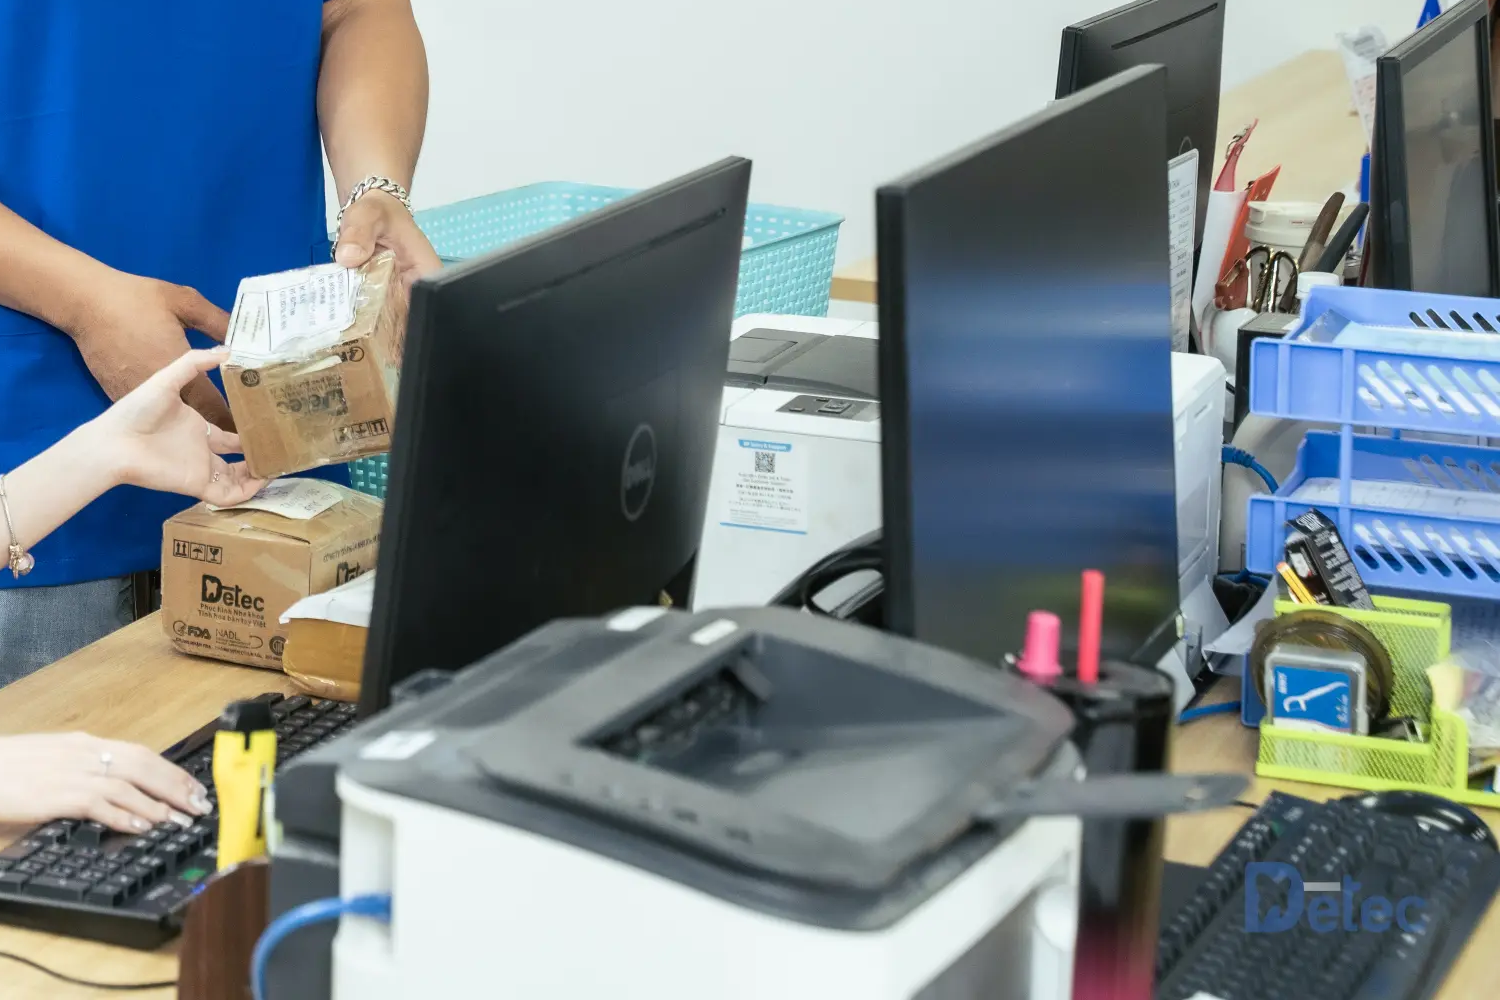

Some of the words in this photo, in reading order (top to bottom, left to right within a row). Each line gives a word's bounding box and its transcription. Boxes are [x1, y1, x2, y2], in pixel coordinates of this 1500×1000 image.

[201, 574, 265, 612] Detec
[188, 625, 212, 640] FDA
[215, 628, 241, 641] NADL
